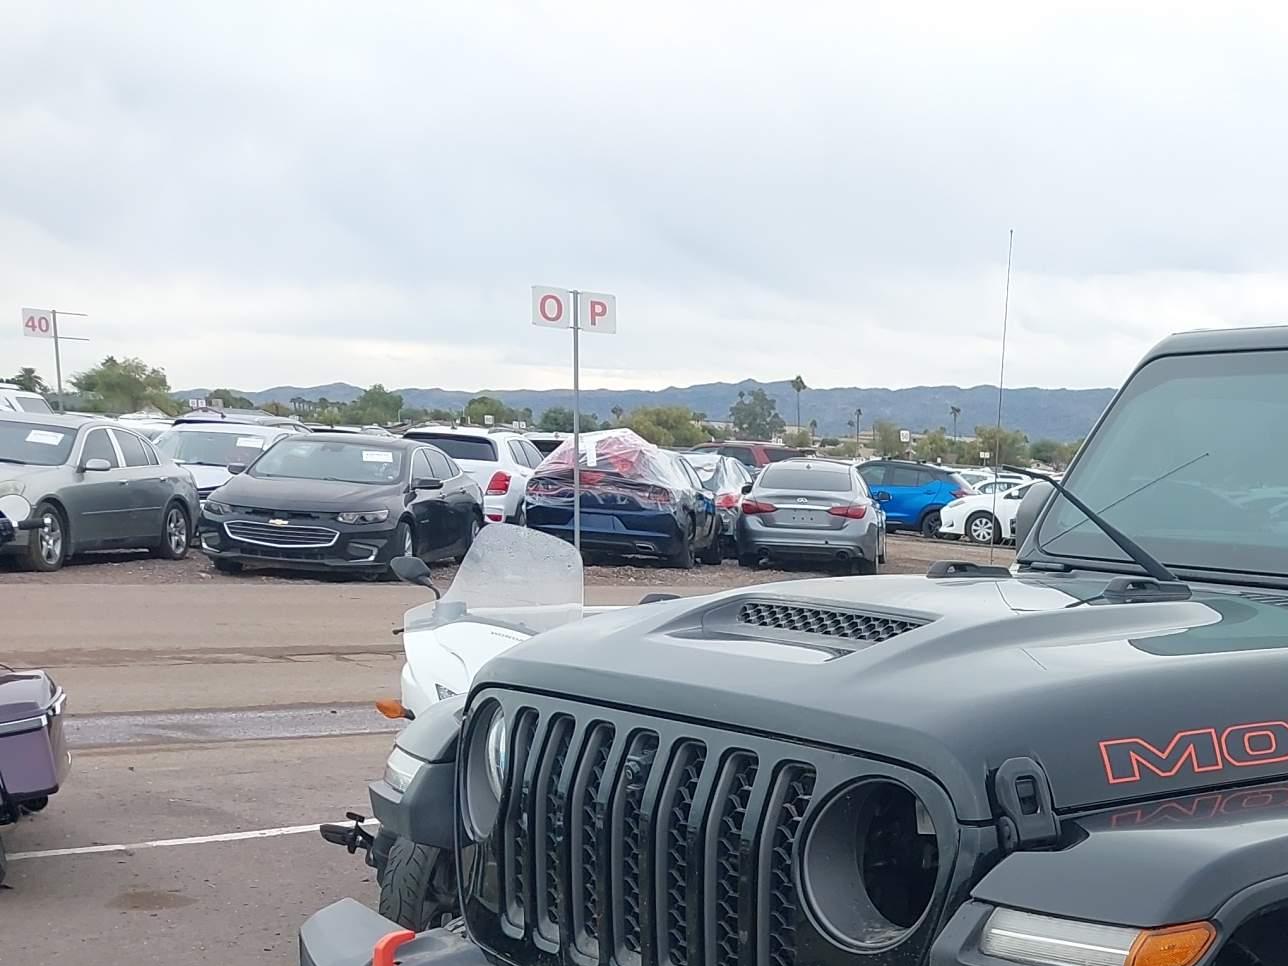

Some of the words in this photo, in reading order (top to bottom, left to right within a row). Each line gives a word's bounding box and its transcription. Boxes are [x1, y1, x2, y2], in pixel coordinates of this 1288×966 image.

[539, 294, 563, 322] O
[590, 300, 608, 326] P
[25, 315, 50, 333] 40
